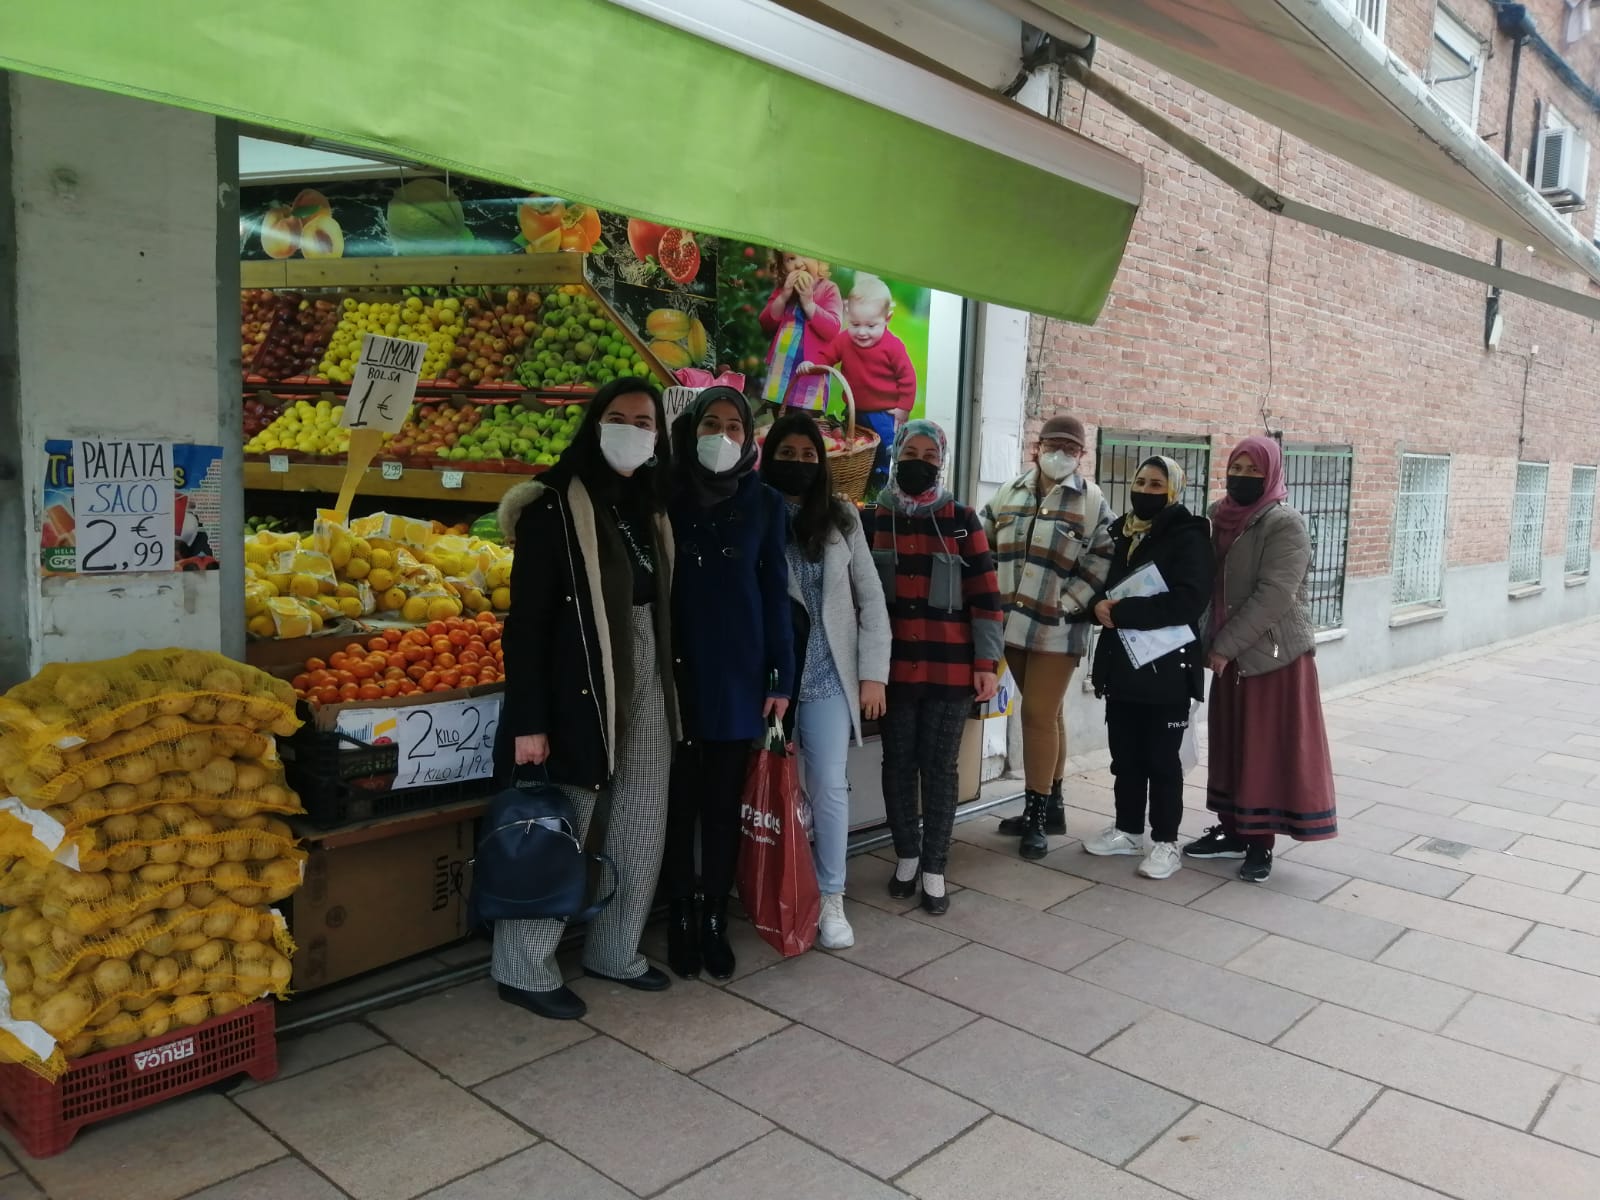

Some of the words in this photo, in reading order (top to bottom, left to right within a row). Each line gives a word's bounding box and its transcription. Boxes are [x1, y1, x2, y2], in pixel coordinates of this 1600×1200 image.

[366, 337, 420, 370] LIMON
[367, 367, 401, 383] BOLSA
[82, 441, 165, 478] PATATA
[88, 484, 158, 513] SACO
[436, 728, 460, 745] KILO
[425, 766, 451, 781] KILO
[134, 1040, 194, 1070] FRUCA
